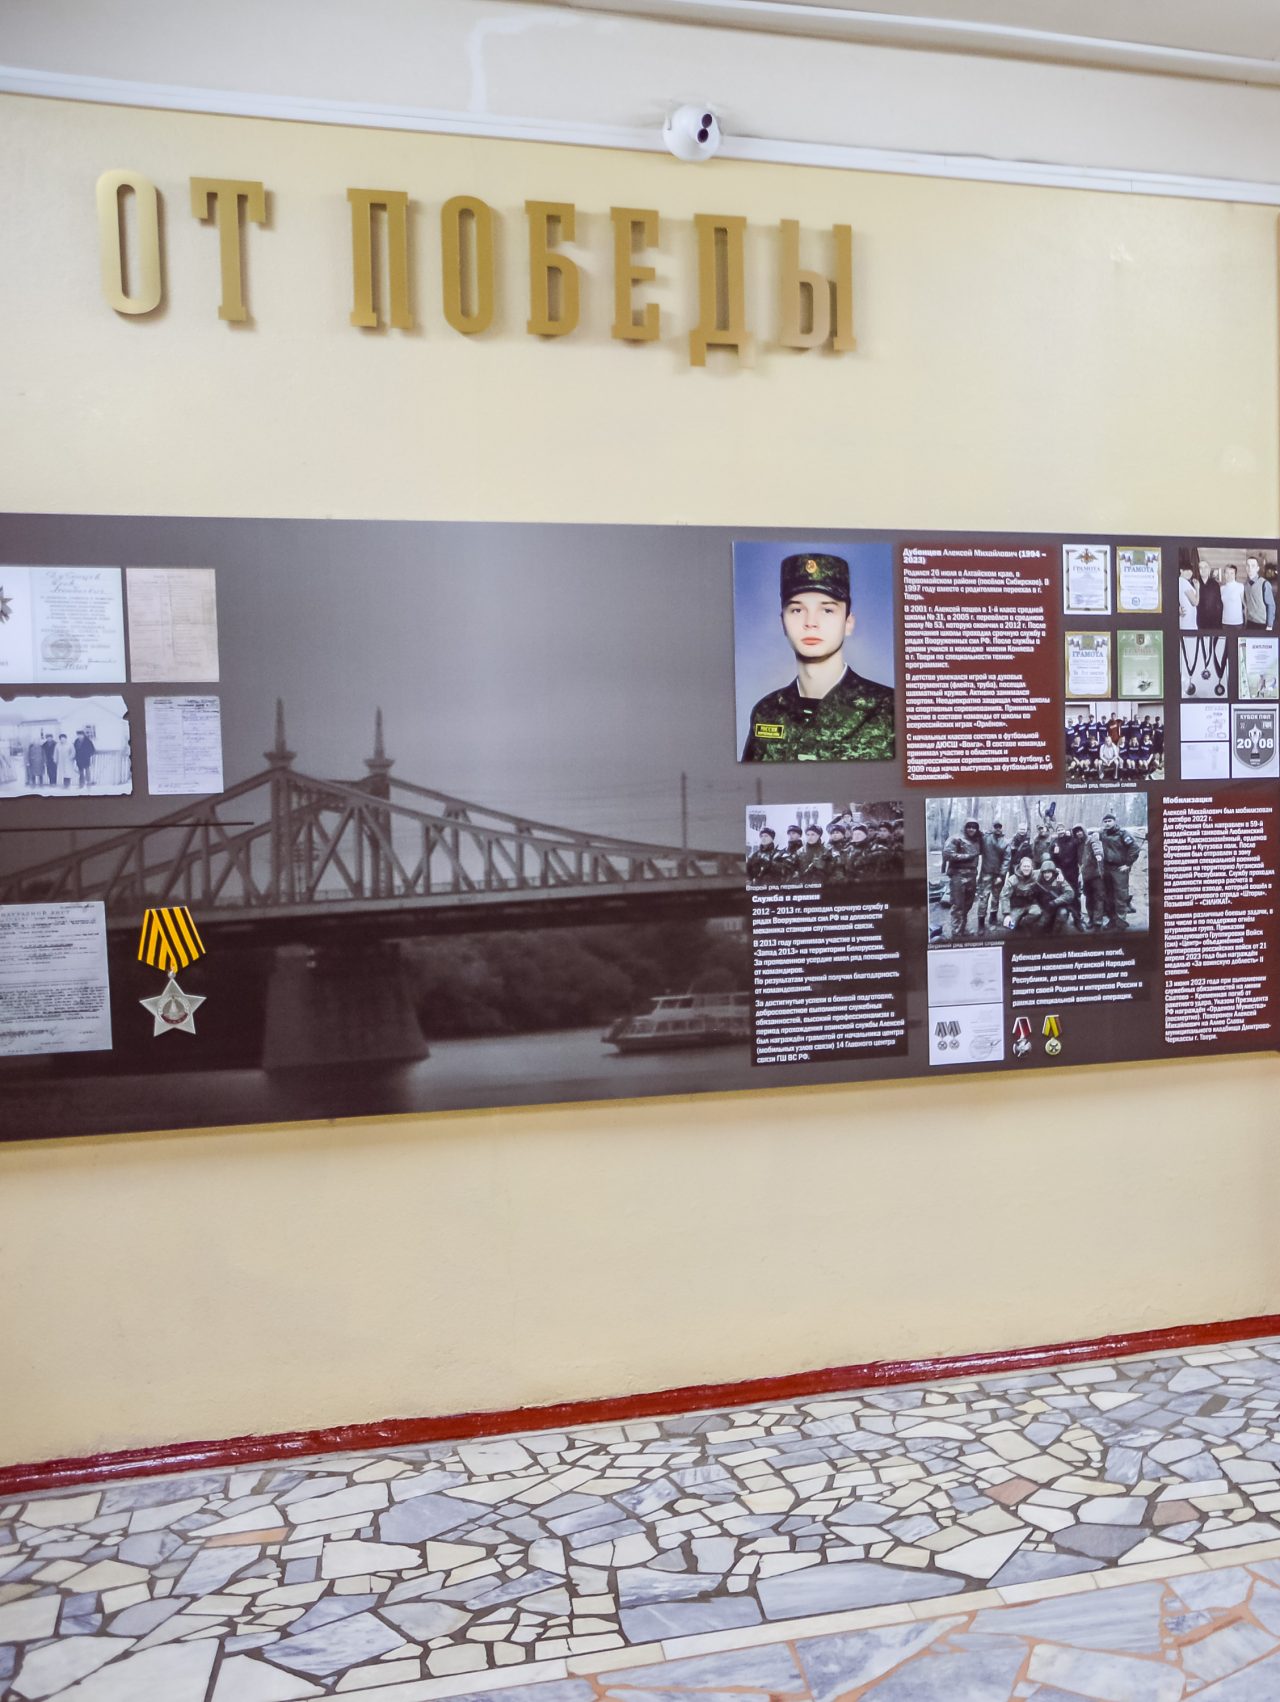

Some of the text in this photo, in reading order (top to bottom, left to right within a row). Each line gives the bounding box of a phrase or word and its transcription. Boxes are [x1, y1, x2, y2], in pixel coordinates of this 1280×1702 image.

[96, 168, 857, 367] ОТ ПОБЕДЫ
[1123, 565, 1155, 573] ГРАМОТА
[1072, 650, 1104, 658] ГРАМОТА
[1236, 738, 1273, 749] 20 08
[752, 894, 784, 904] Служба
[752, 907, 770, 916] 2012
[776, 906, 794, 914] 2013
